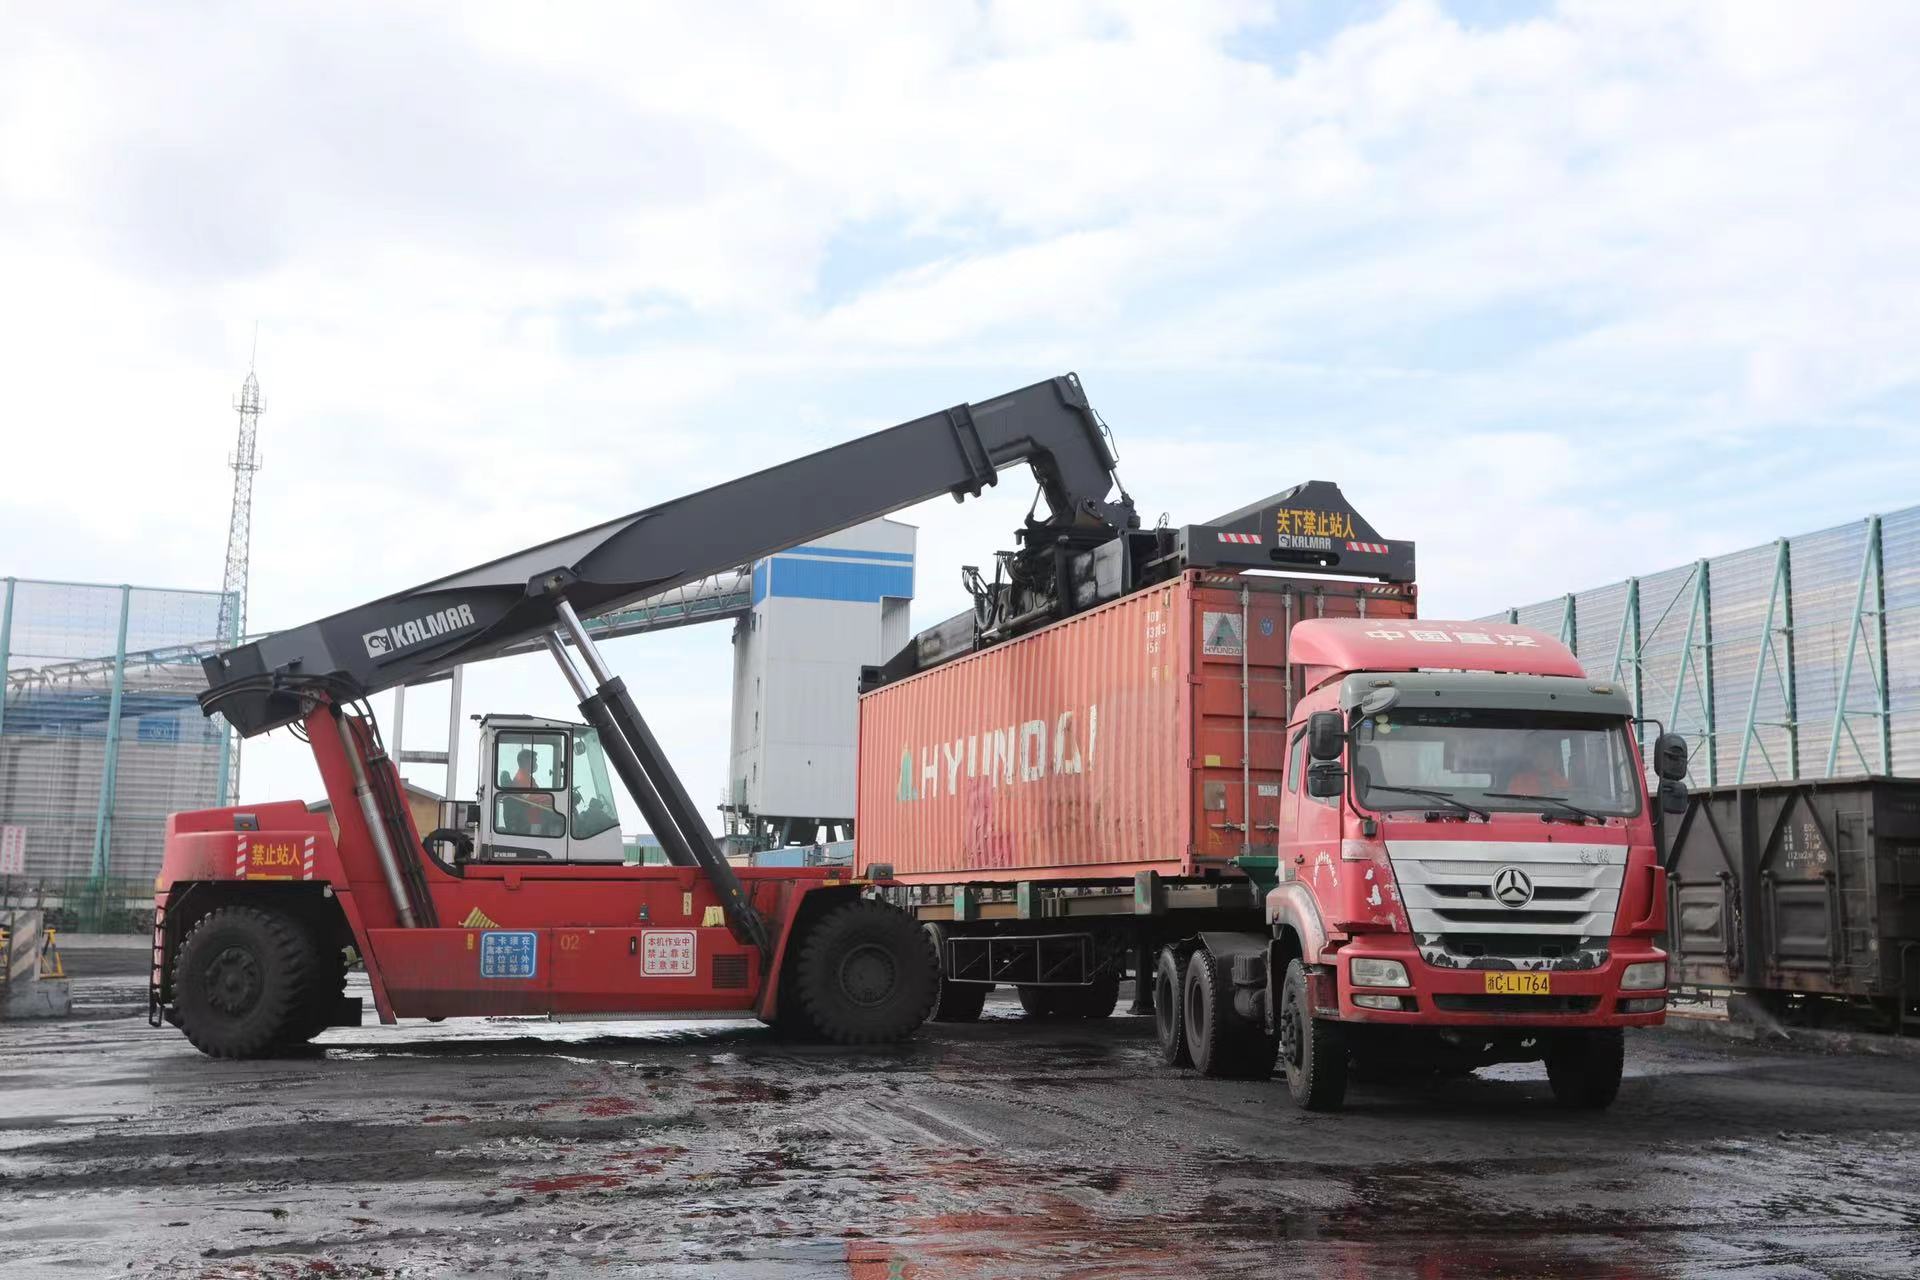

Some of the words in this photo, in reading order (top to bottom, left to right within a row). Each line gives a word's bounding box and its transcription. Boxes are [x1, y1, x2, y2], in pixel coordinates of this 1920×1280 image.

[1277, 508, 1356, 539] 关下禁止站人
[1291, 535, 1332, 549] KALMAR
[390, 603, 475, 649] KALMAR
[1365, 629, 1541, 648] 中国重汽
[1204, 646, 1242, 655] HYUNDA
[252, 843, 300, 866] 禁止站人
[560, 933, 580, 951] 02
[648, 937, 690, 947] 本机作业中
[647, 949, 690, 959] 禁止靠近
[647, 960, 690, 970] 注意避让
